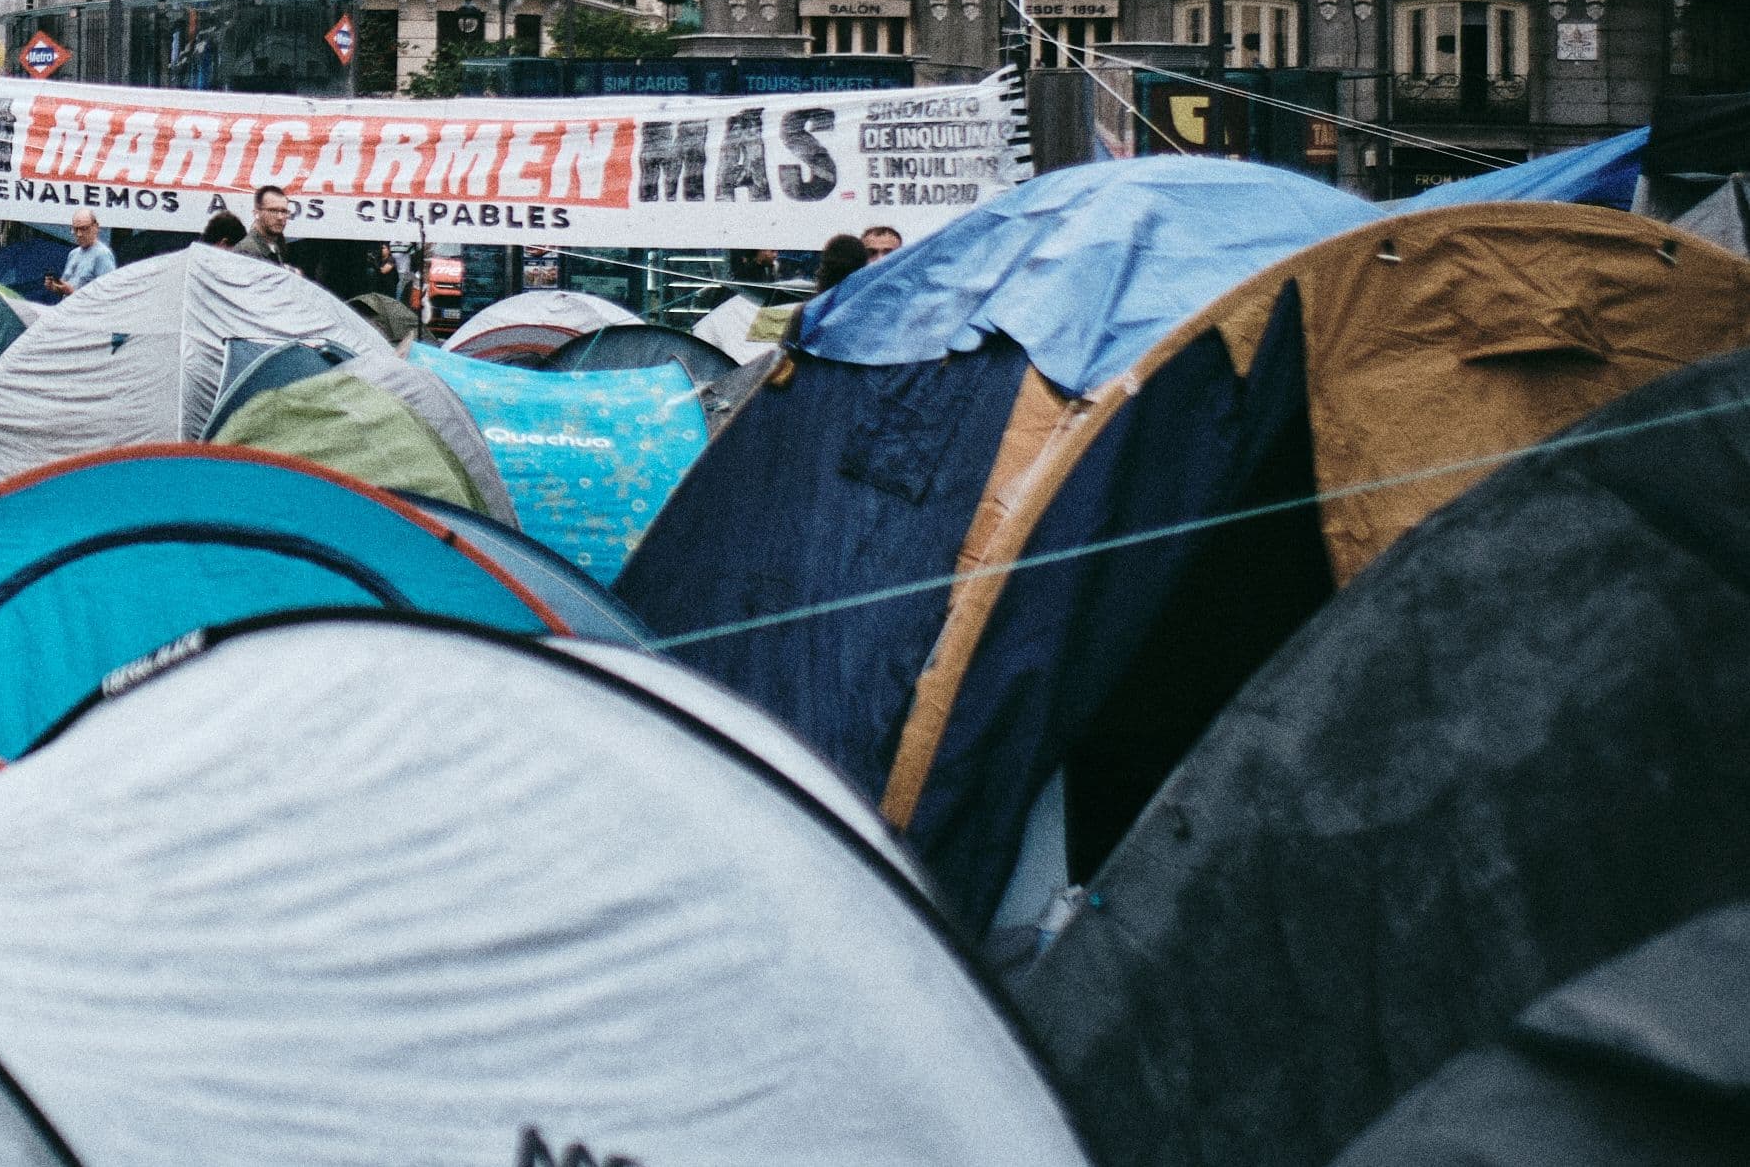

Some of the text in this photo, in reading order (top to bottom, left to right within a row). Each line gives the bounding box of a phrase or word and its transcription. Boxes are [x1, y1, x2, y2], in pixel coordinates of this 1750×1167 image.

[1025, 3, 1108, 15] ESDE 1894
[27, 49, 55, 64] Metro
[603, 76, 630, 91] SIM
[635, 76, 688, 91] CARDS
[866, 96, 980, 122] SINDICATO
[864, 127, 892, 149] DE
[35, 102, 614, 198] MARICARMEN
[868, 157, 879, 179] E
[868, 182, 980, 206] DE MADRID
[208, 194, 228, 215] A
[356, 199, 571, 229] CULPABLES
